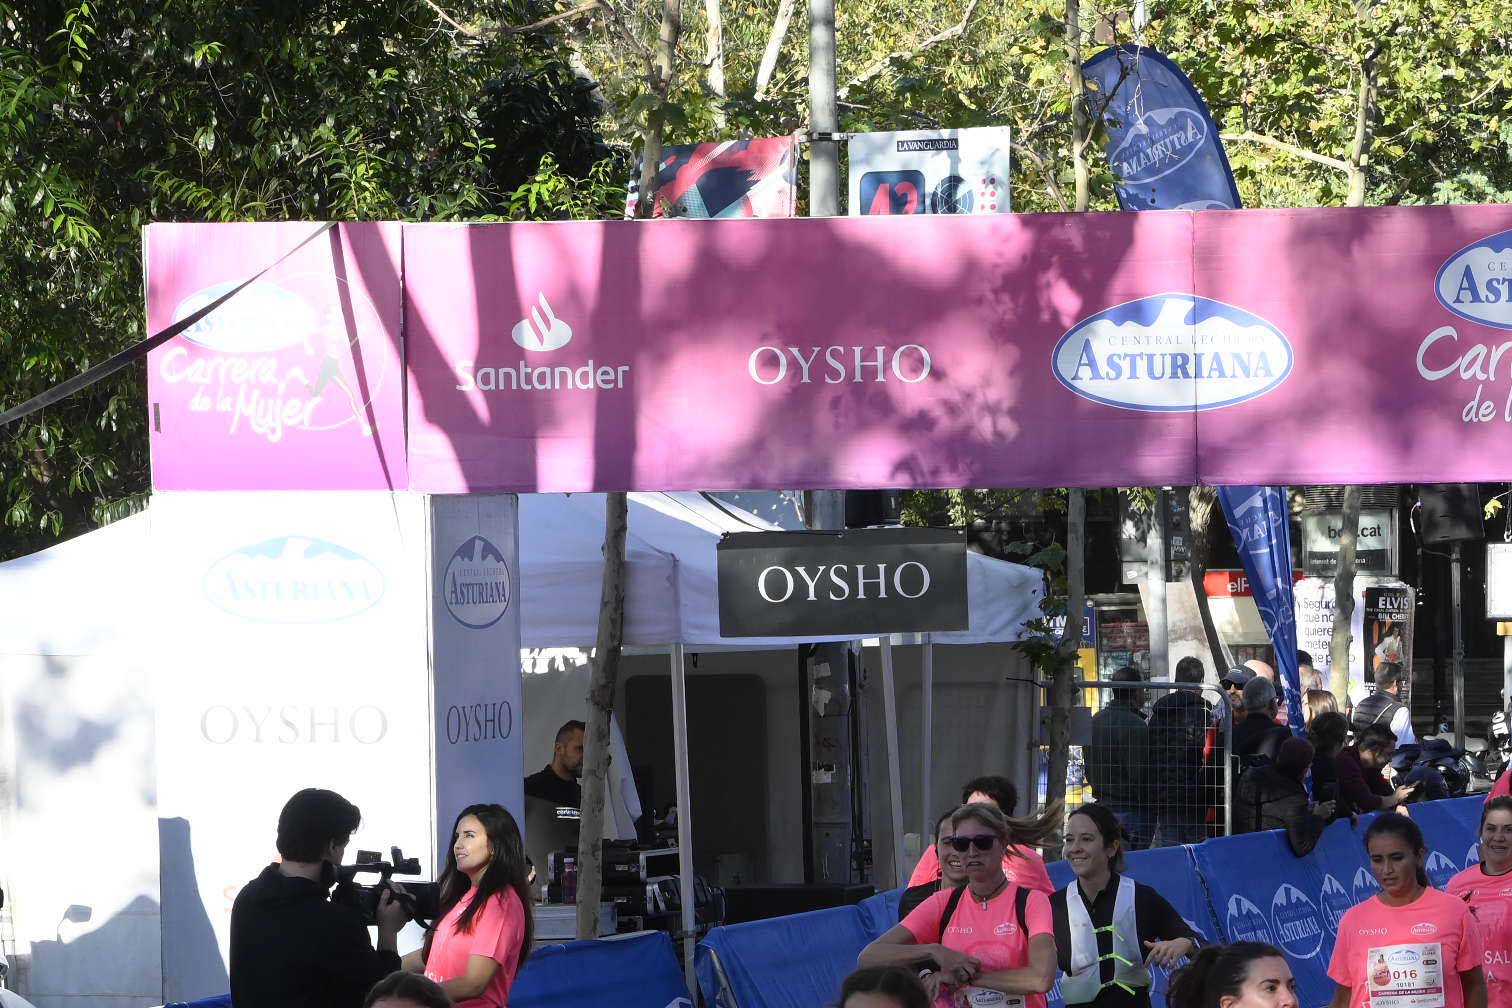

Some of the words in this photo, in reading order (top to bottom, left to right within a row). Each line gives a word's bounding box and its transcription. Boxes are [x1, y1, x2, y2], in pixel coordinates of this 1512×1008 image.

[908, 138, 957, 151] VANGUARDIA
[160, 346, 278, 383] Carrera
[455, 359, 630, 391] Santander
[749, 344, 932, 386] OYSHO
[1070, 336, 1273, 381] ASTURIANA
[229, 382, 323, 443] Mujer
[1461, 385, 1498, 423] de
[449, 571, 507, 607] ASTURIANA
[757, 561, 931, 603] OYSHO
[1378, 596, 1410, 611] ELVIS
[200, 704, 388, 745] OYSHO
[446, 700, 512, 745] OYSHO
[1393, 969, 1418, 980] 016
